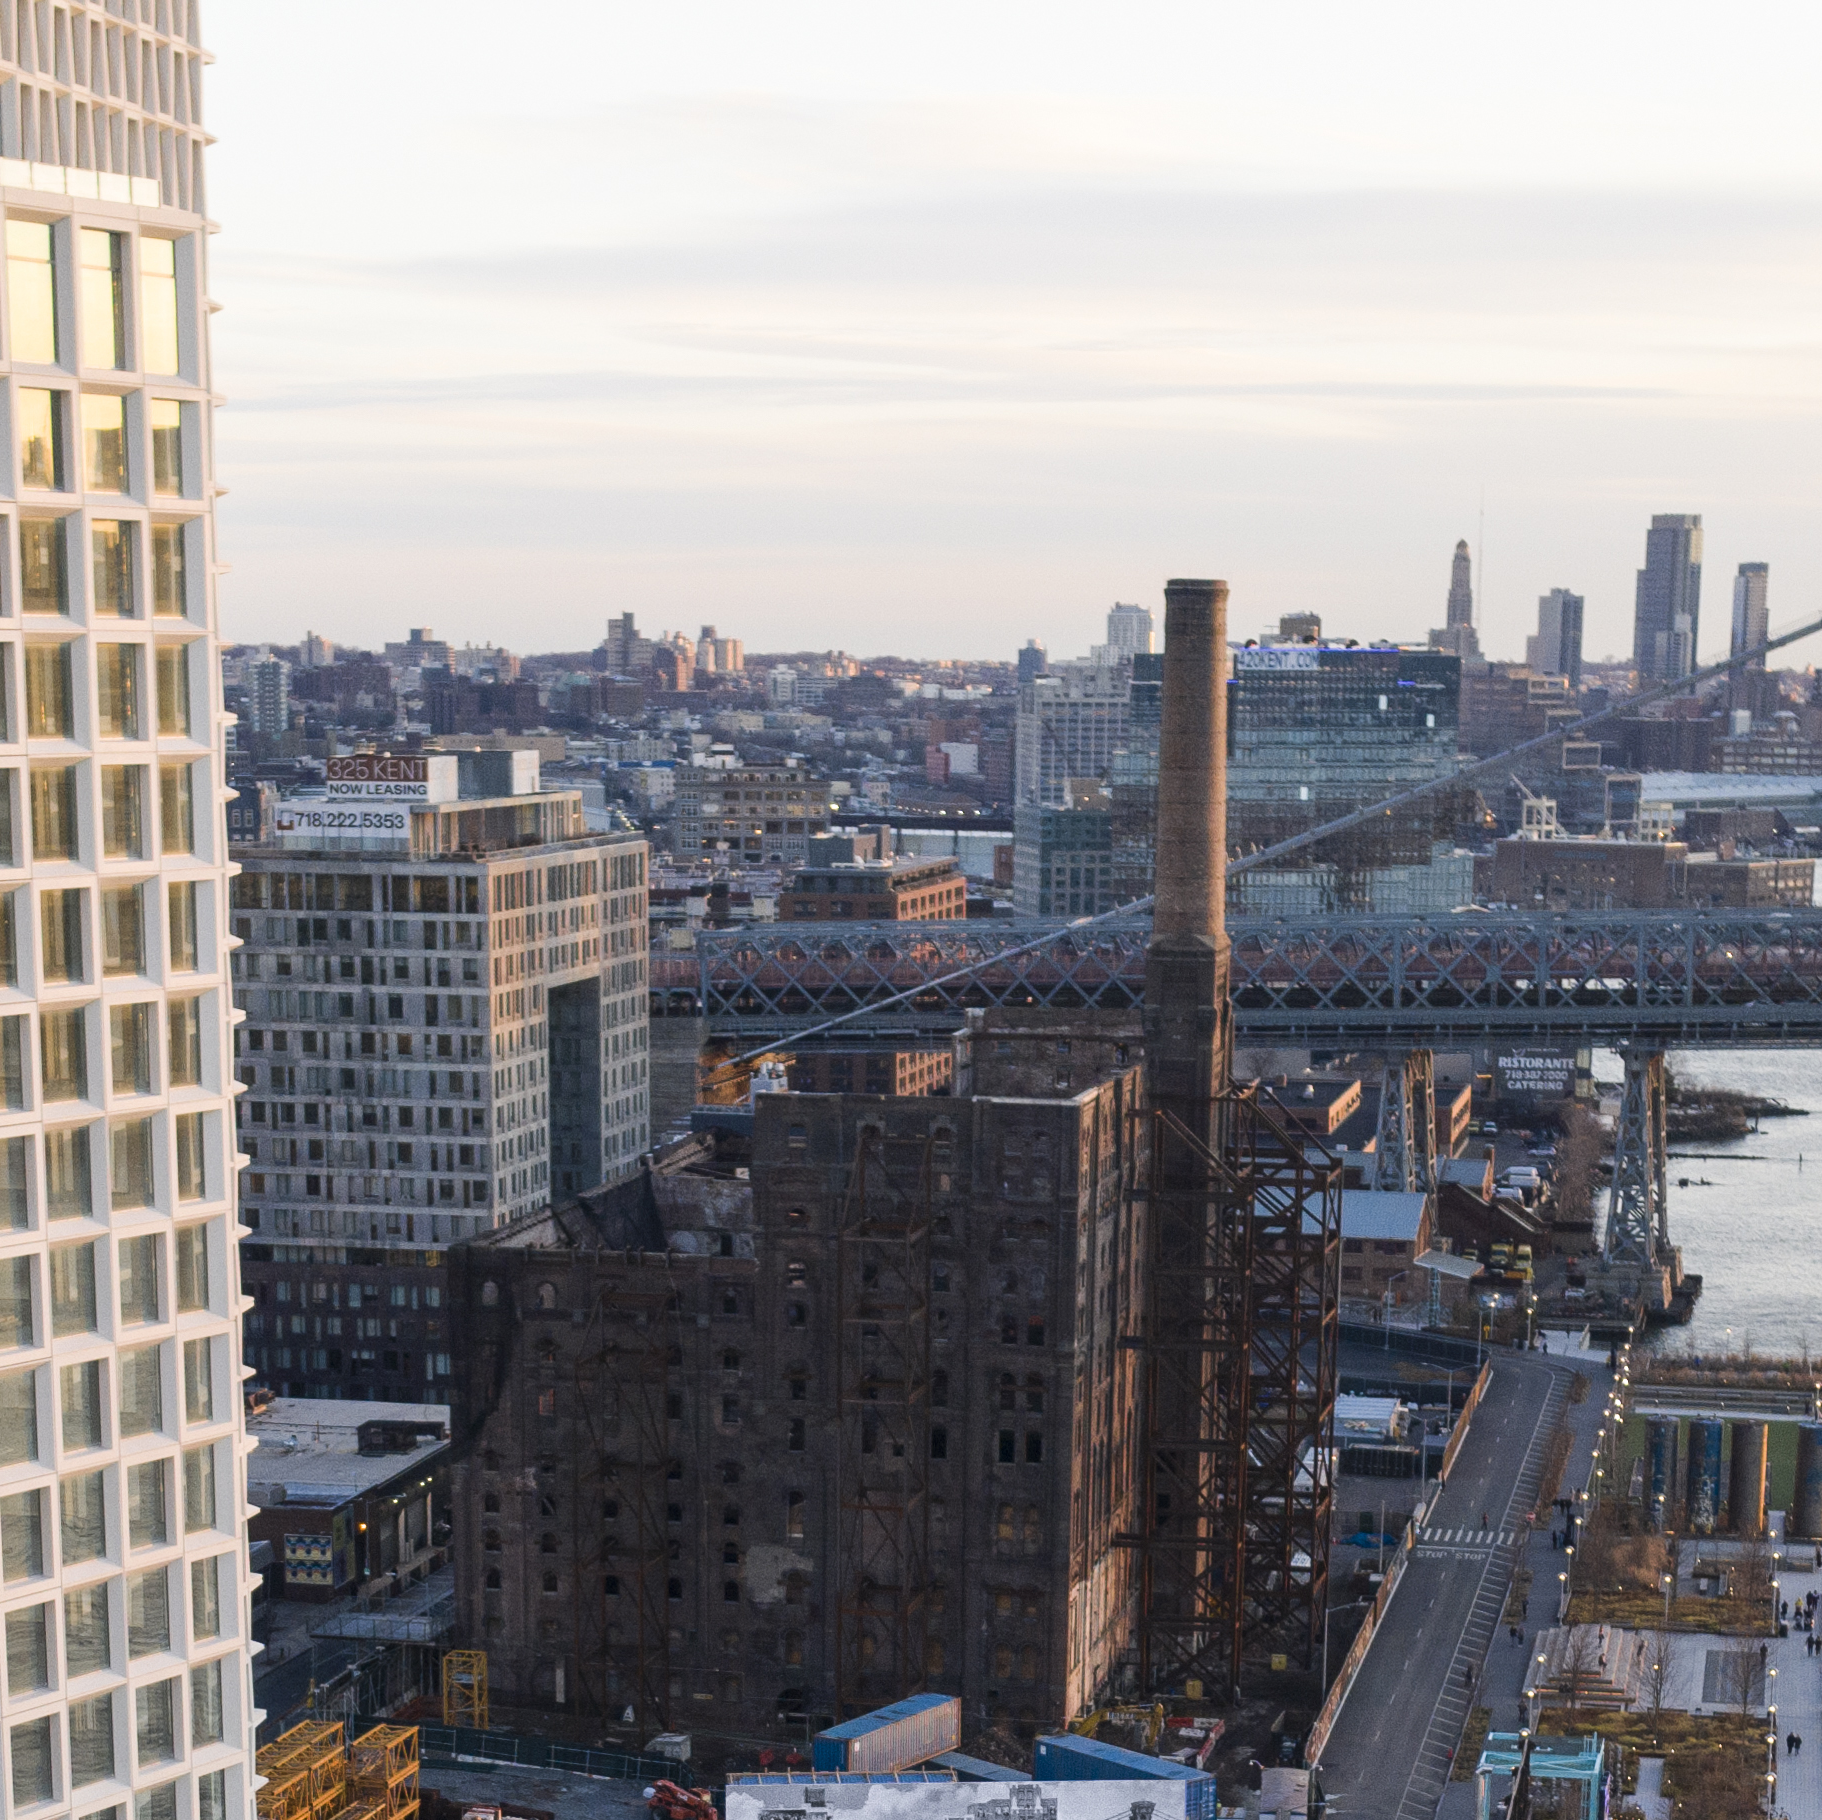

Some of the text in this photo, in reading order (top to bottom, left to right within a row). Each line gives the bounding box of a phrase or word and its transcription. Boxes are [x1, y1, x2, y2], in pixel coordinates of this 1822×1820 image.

[329, 758, 427, 780] 325 KENT
[330, 783, 428, 796] NOW LEASING
[294, 812, 406, 829] 718.222.5353
[1498, 1056, 1576, 1069] RISTORANTE
[1416, 1550, 1487, 1560] STOP STOP
